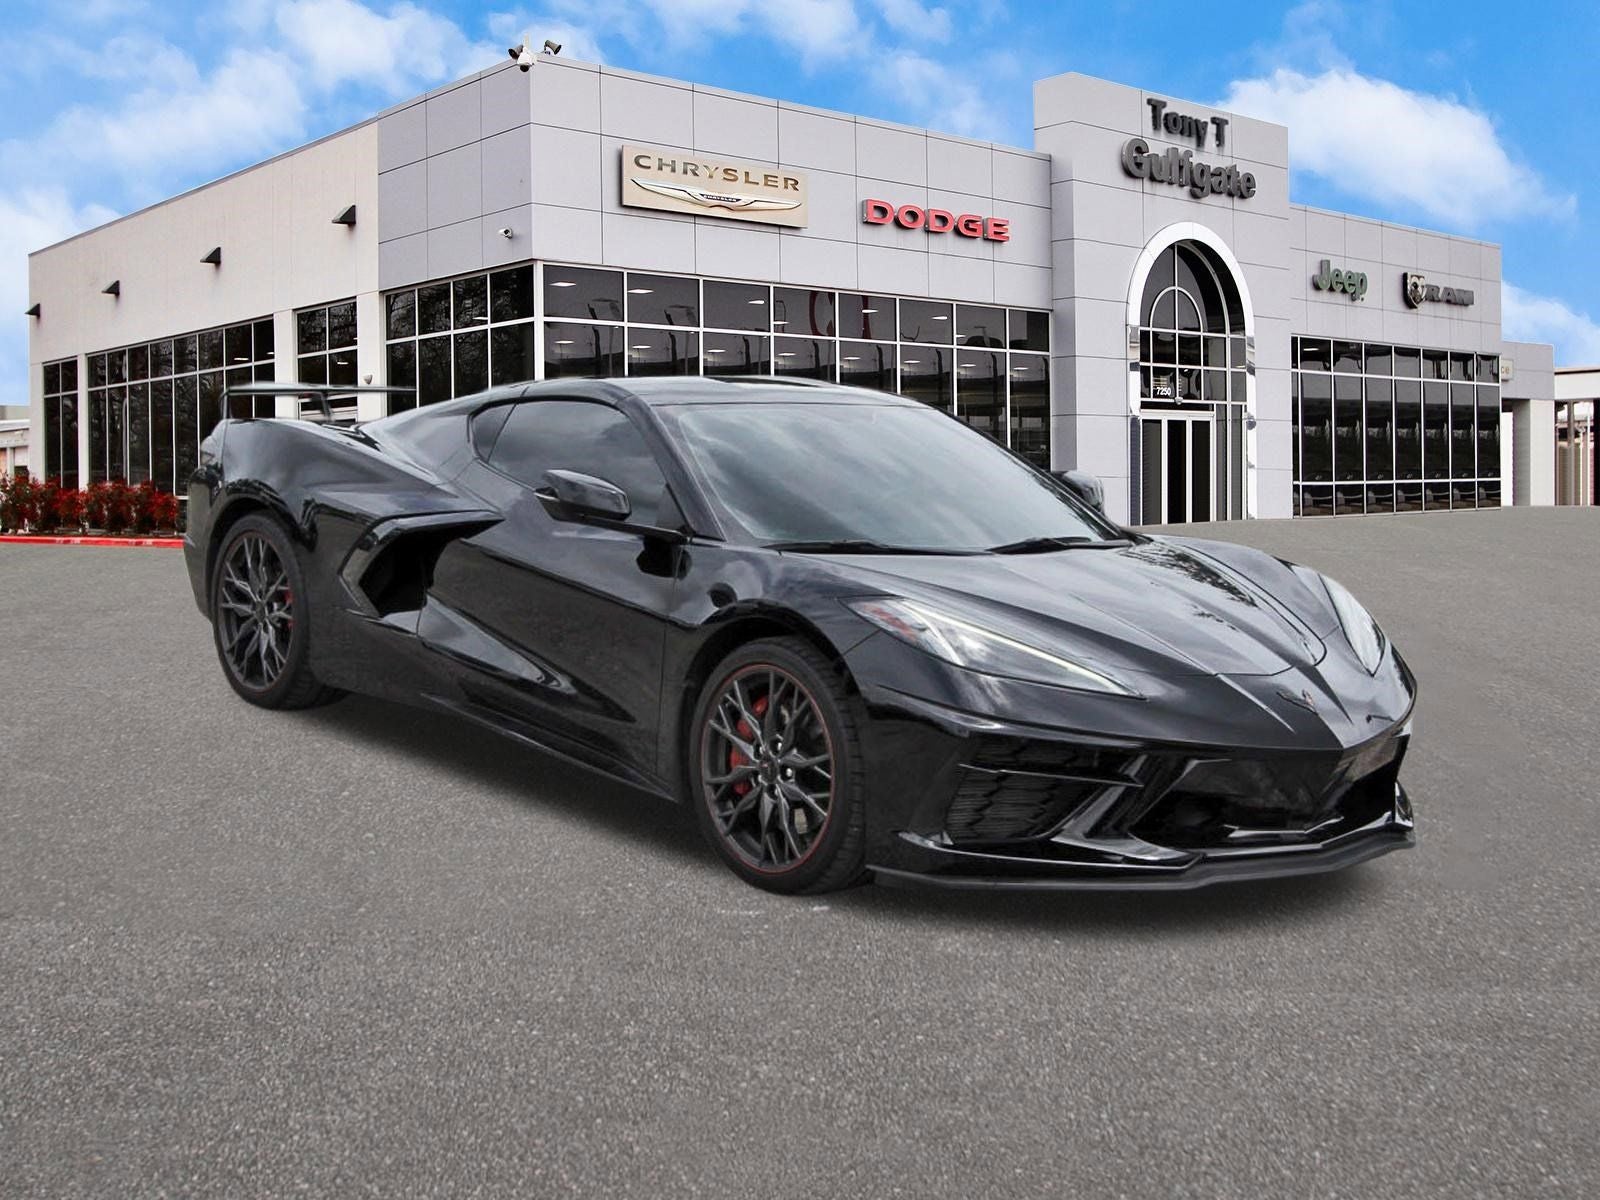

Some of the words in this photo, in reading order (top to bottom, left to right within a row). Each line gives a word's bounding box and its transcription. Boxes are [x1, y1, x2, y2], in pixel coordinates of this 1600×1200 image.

[1147, 98, 1208, 147] Tony
[1210, 116, 1229, 147] T
[633, 154, 801, 192] CHRYSLER
[1121, 138, 1257, 199] Gulfgate
[862, 199, 1010, 242] DODGE
[1312, 259, 1368, 301] Jeep
[1424, 283, 1475, 307] RAM
[1156, 386, 1171, 396] 7250
